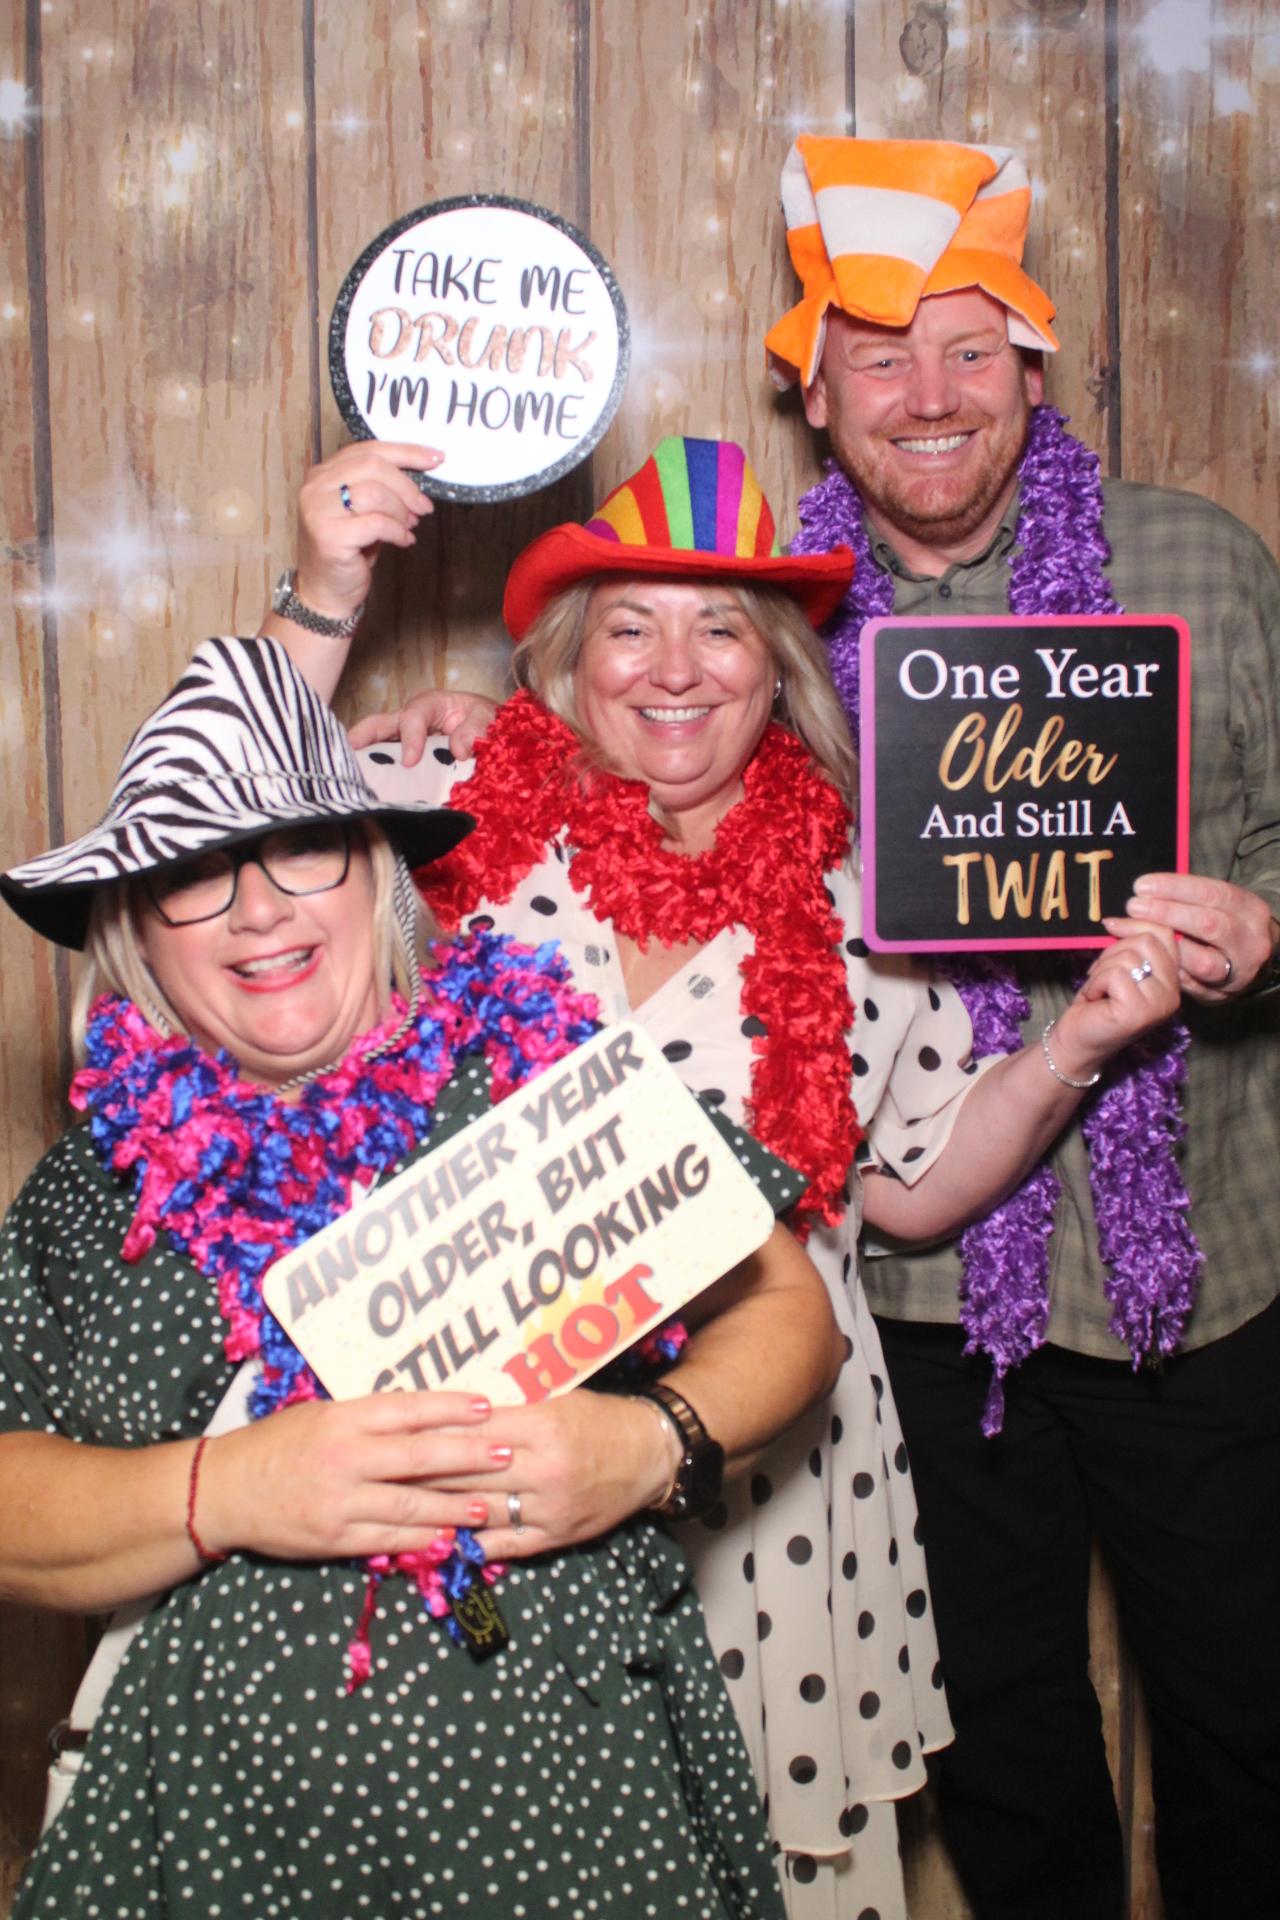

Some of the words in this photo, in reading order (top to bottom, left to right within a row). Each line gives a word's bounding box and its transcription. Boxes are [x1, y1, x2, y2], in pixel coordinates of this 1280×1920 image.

[392, 249, 503, 305] TAKE
[519, 264, 592, 315] ME
[368, 306, 598, 382] DRUNK
[365, 370, 430, 423] I'M
[445, 379, 586, 440] HOME
[898, 649, 1021, 701] One
[1034, 648, 1161, 699] Year
[938, 702, 1119, 794] Older
[919, 801, 1005, 839] And
[1015, 799, 1094, 837] Still
[1101, 800, 1137, 836] A
[942, 849, 1114, 926] TWAT
[287, 1121, 518, 1324] ANOTHER
[519, 1029, 645, 1145] YEAR
[367, 1199, 536, 1339] OLDER,
[535, 1113, 626, 1215] BUT
[500, 1143, 710, 1327] LOOKING
[501, 1263, 663, 1403] HOT
